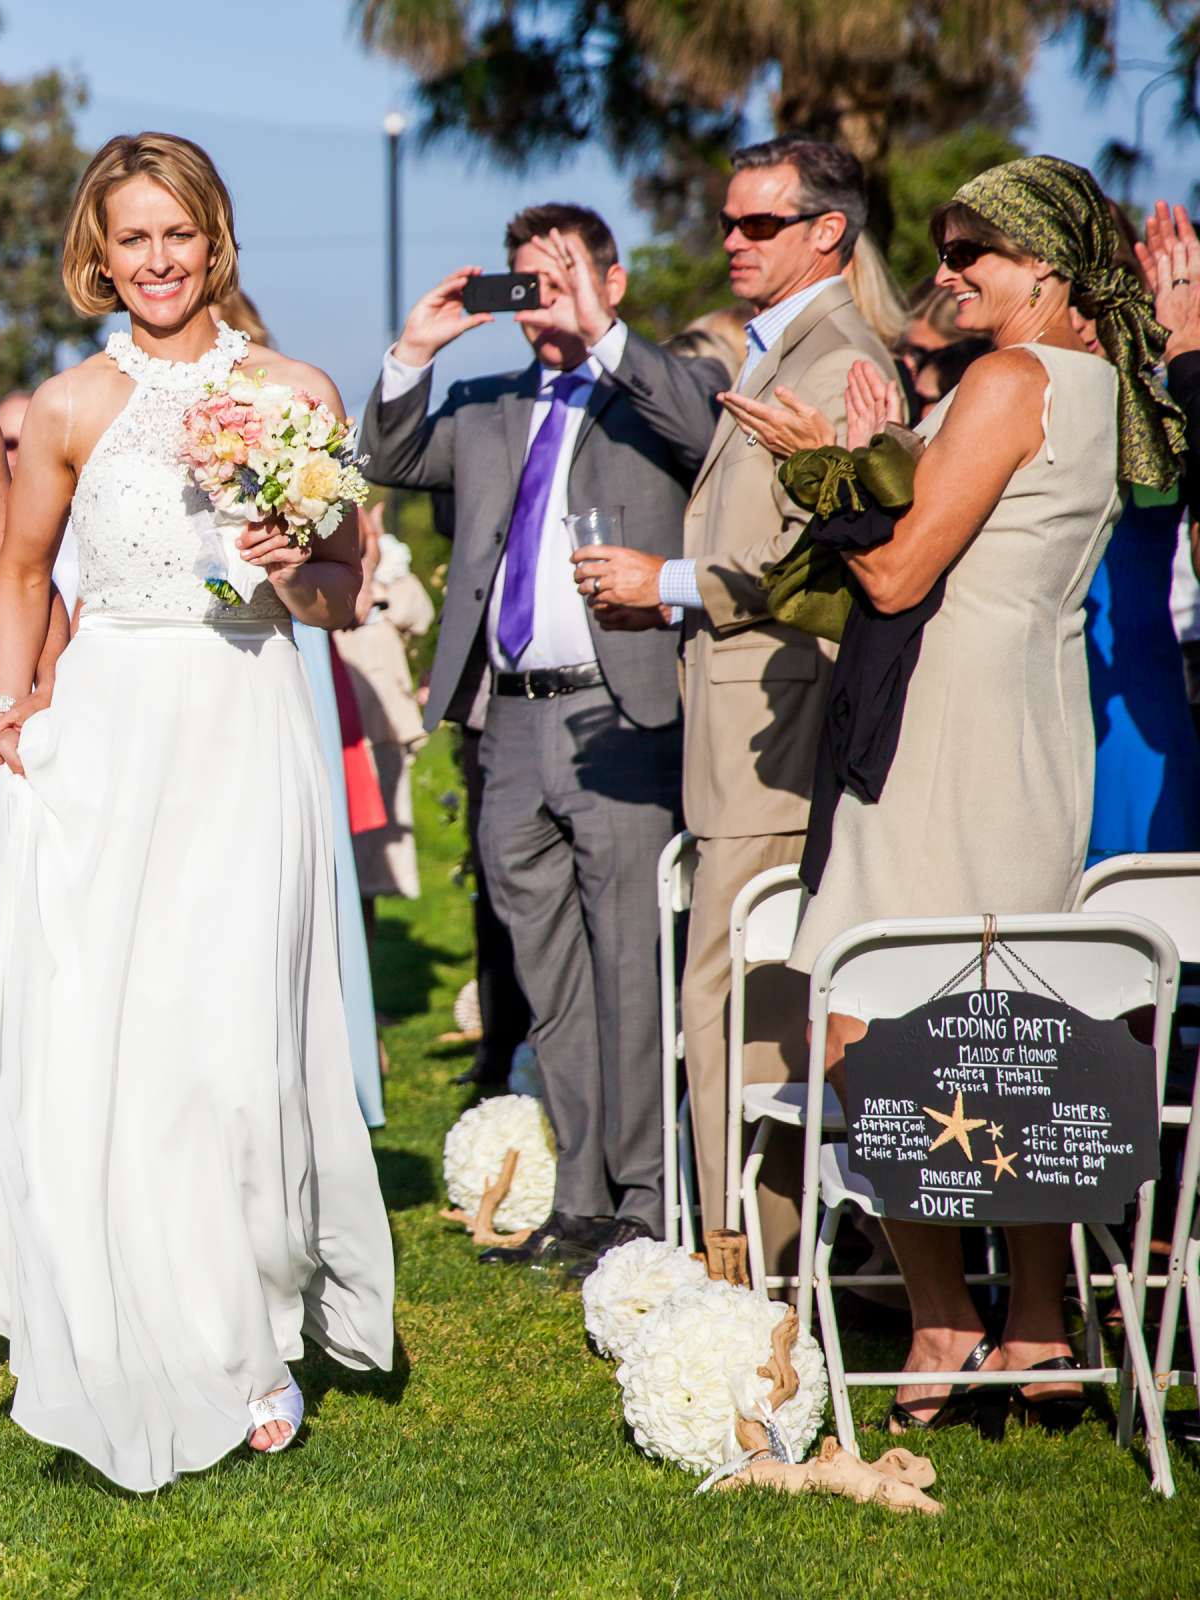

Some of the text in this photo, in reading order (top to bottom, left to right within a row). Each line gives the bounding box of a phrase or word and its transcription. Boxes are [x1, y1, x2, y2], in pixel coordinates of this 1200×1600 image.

[968, 991, 1011, 1016] OUR
[928, 1017, 1072, 1043] WEDDING PARTY:
[959, 1045, 1058, 1064] MAIDS OF HONOR
[943, 1064, 985, 1081] Andrea
[946, 1081, 1051, 1096] Jessica Thompson
[864, 1098, 918, 1115] PARENTS:
[1052, 1102, 1110, 1120] USHERS:
[861, 1118, 926, 1133] Barbara Cook
[1031, 1123, 1109, 1140] Eric Meline
[863, 1132, 897, 1146] Margie
[1032, 1138, 1134, 1154] Eric Greathouse
[864, 1146, 928, 1161] Eddie Ingalls
[1033, 1153, 1079, 1168] Vincent
[920, 1168, 982, 1186] RINGBEAR
[1035, 1169, 1098, 1187] Austin Cox
[921, 1194, 975, 1218] DUKE
